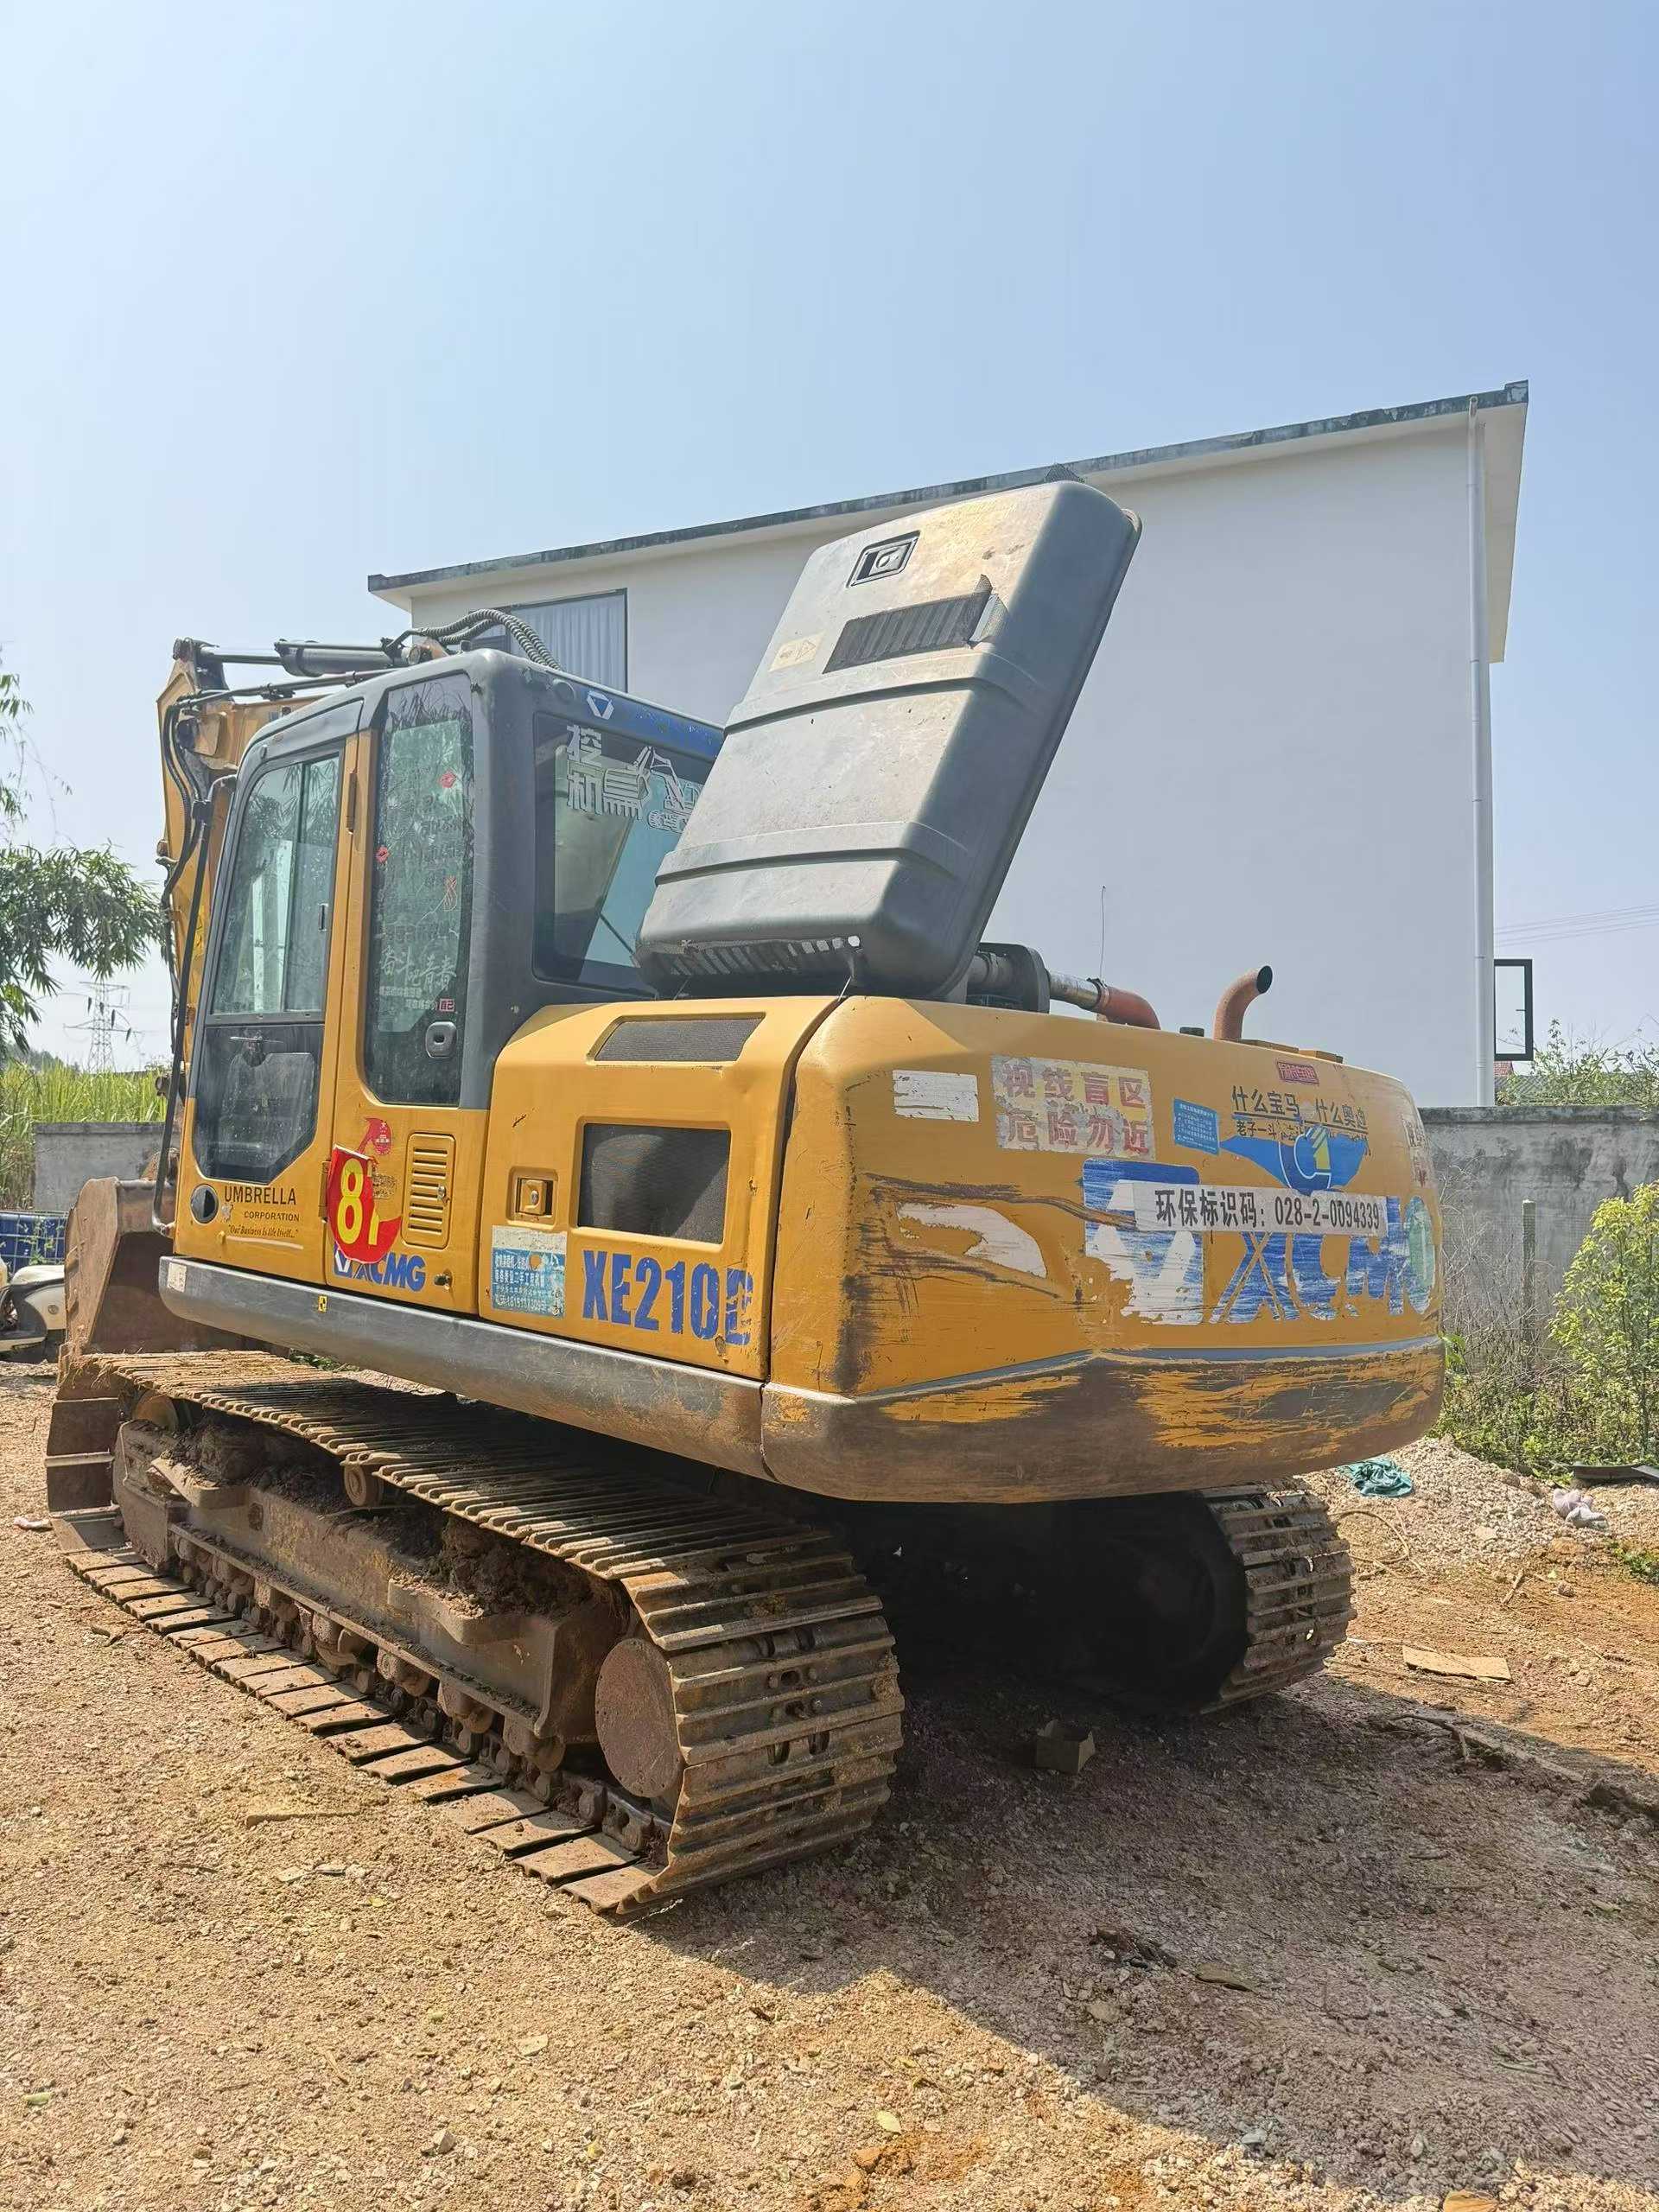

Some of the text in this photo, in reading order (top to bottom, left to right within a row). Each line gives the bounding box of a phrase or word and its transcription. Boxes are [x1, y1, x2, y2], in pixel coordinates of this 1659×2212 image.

[1002, 1062, 1147, 1109] 视线盲区
[1231, 1085, 1301, 1122] 什么宝马
[1006, 1103, 1149, 1155] 危险勿近
[224, 1185, 296, 1205] UMBRELLA
[244, 1211, 300, 1222] CORPORATION
